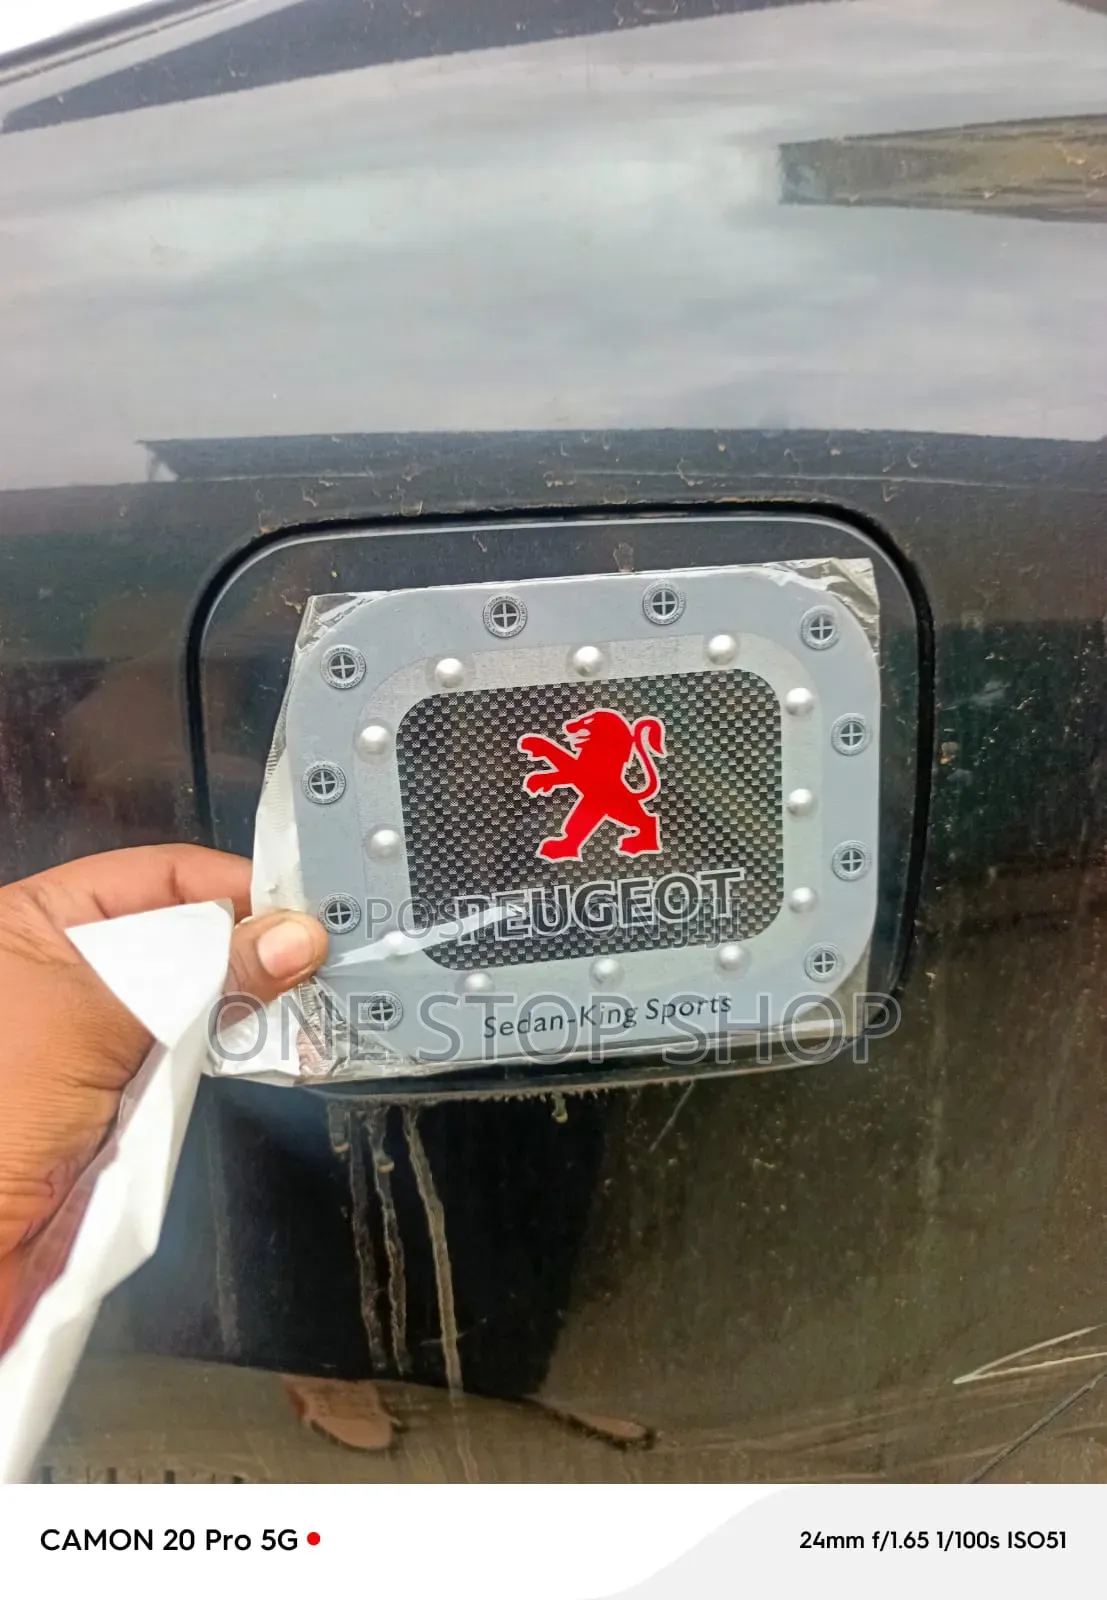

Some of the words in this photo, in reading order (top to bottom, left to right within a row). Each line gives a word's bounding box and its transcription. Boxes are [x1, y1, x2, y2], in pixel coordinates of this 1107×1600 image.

[455, 867, 745, 946] PEUGEOT
[484, 1004, 638, 1039] Sedan-King
[646, 995, 732, 1024] Sports
